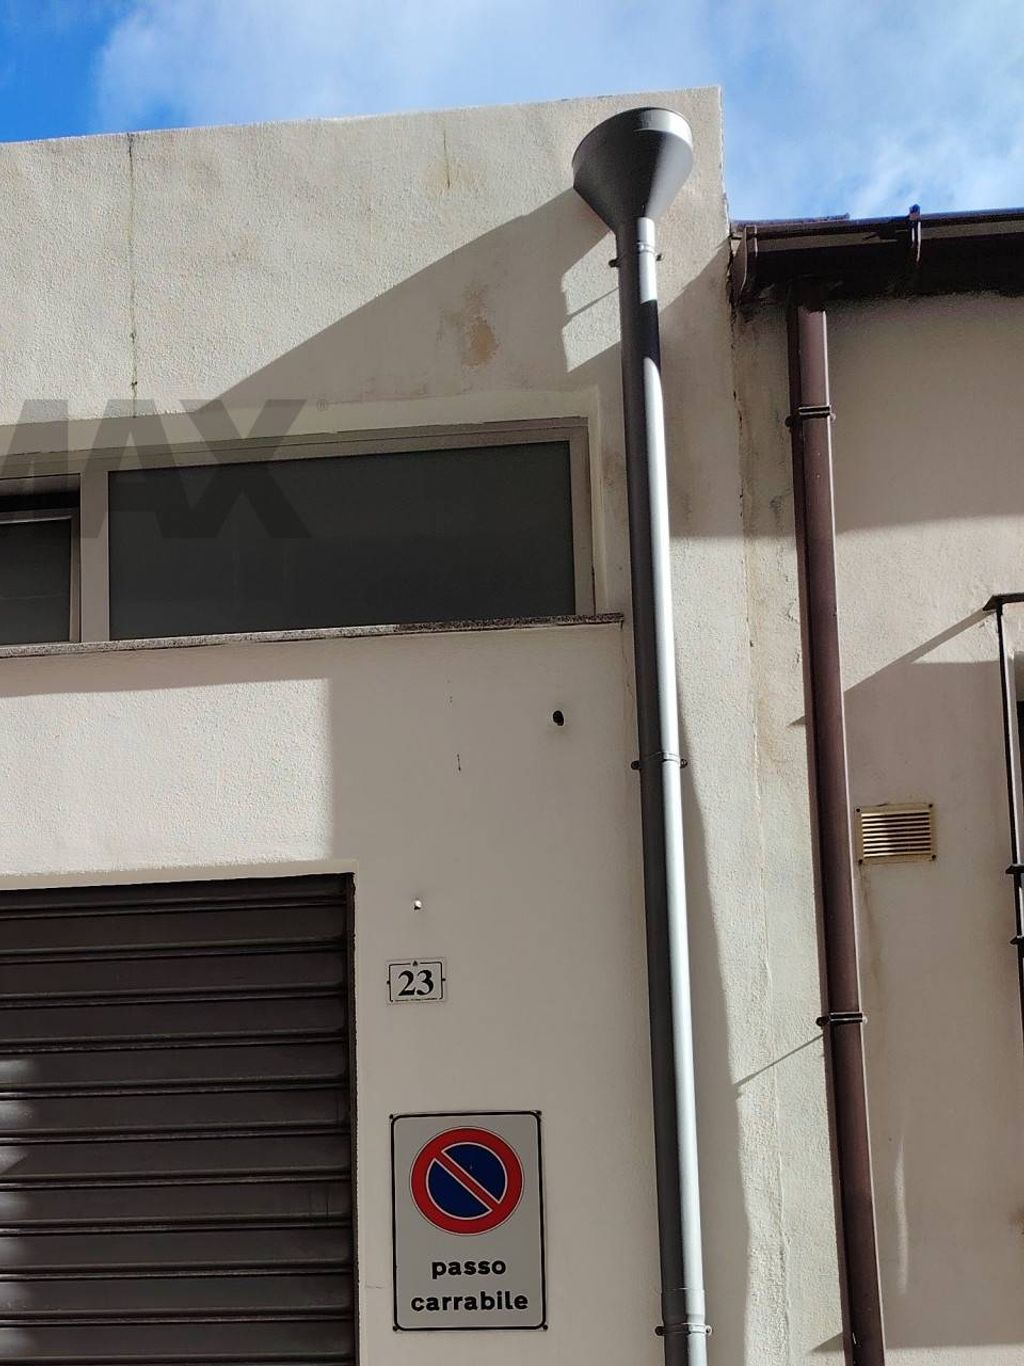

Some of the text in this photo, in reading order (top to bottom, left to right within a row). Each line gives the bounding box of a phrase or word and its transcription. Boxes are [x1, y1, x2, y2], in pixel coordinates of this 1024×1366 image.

[398, 970, 434, 996] 23
[432, 1260, 506, 1279] passo
[411, 1291, 528, 1311] carrabile
